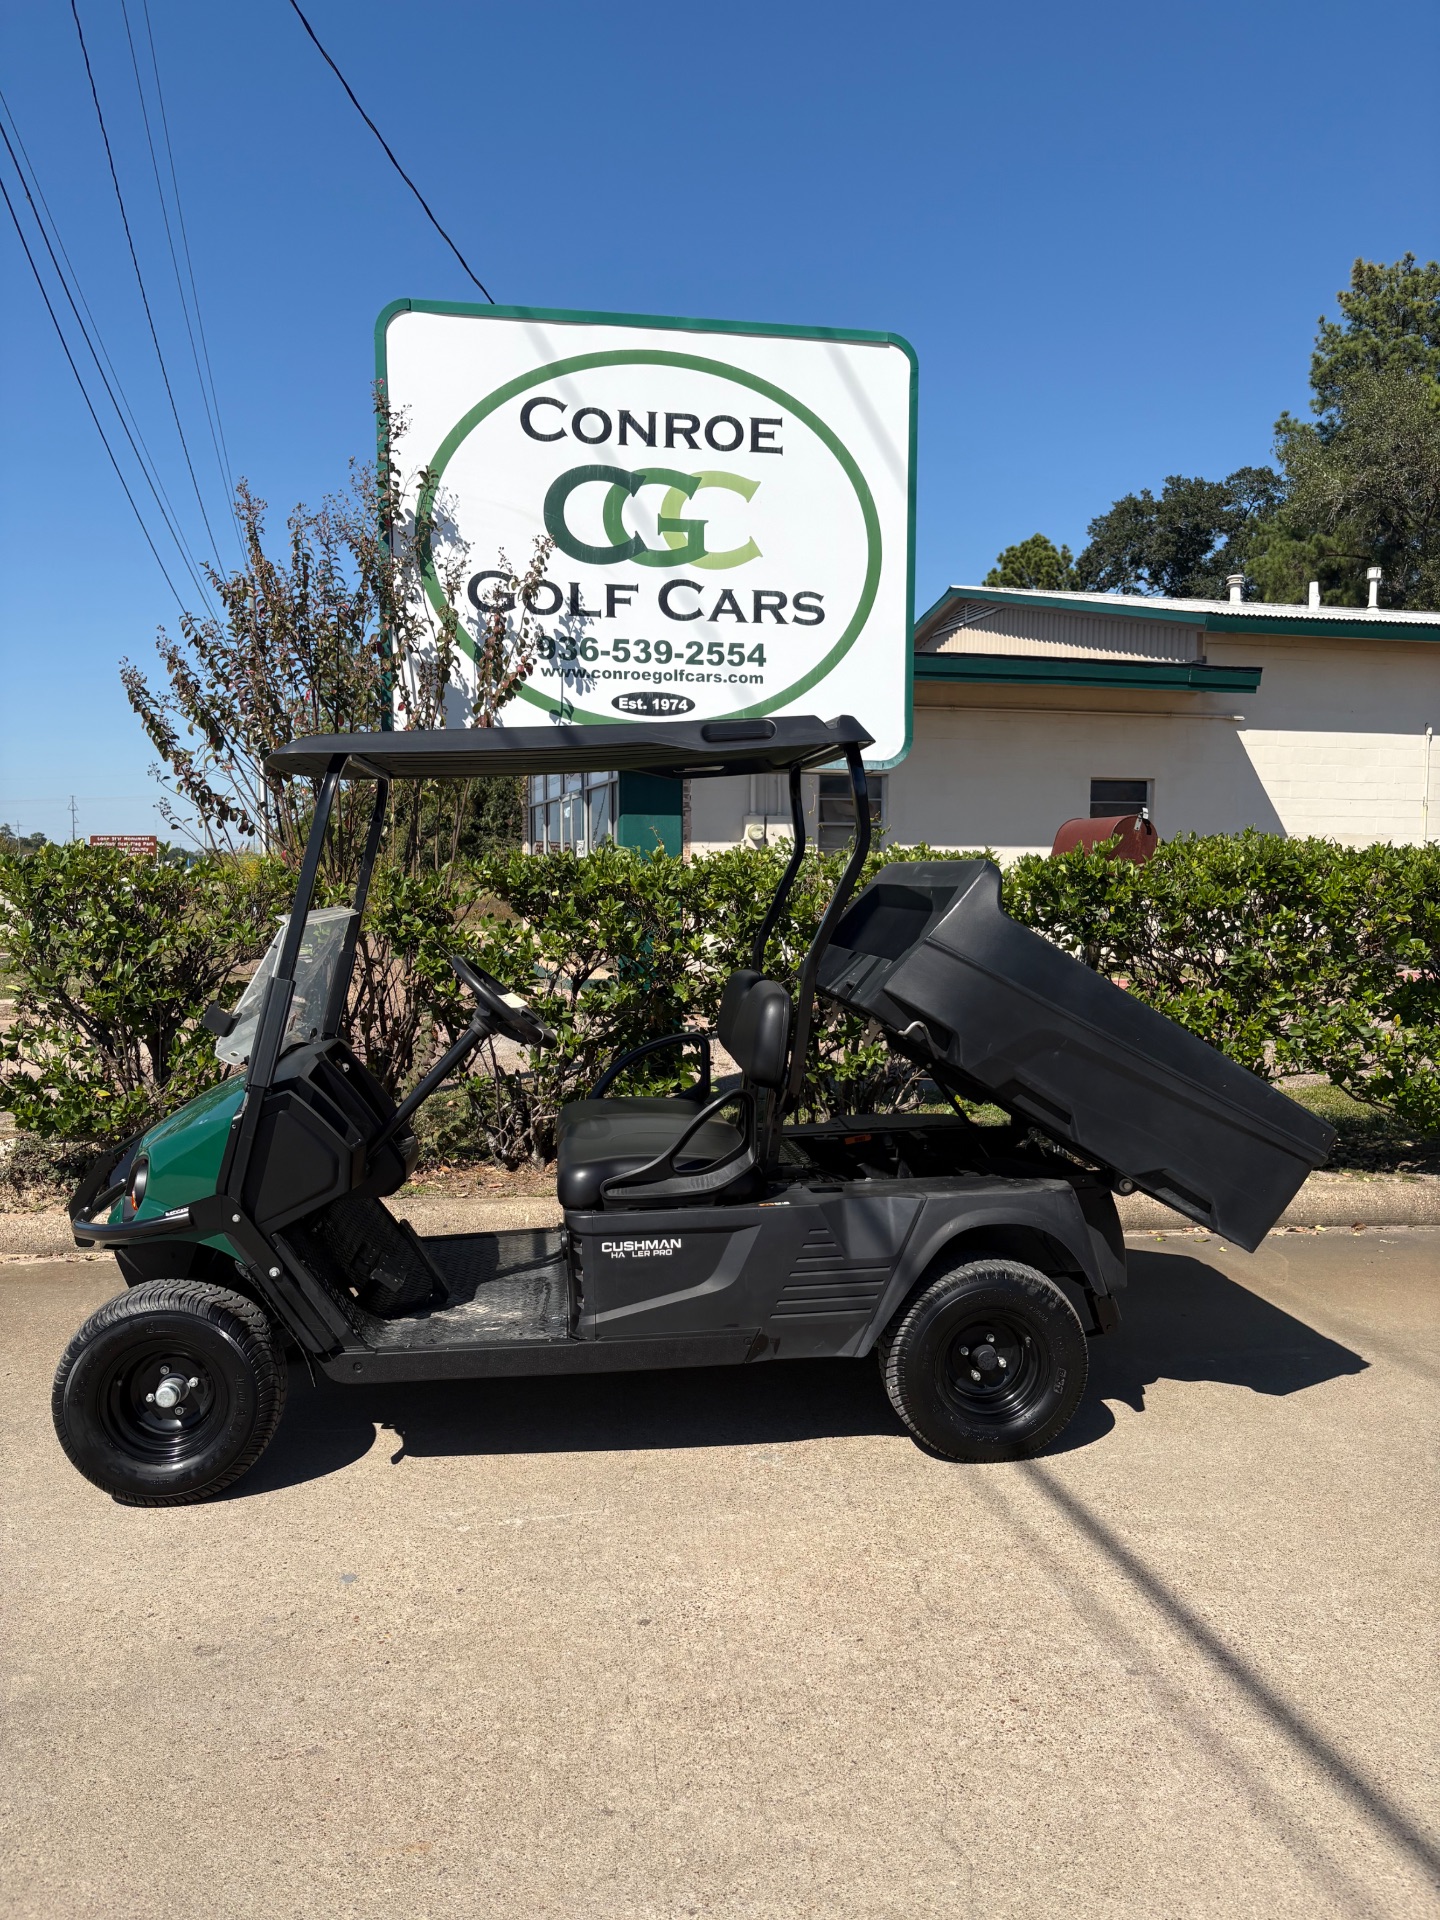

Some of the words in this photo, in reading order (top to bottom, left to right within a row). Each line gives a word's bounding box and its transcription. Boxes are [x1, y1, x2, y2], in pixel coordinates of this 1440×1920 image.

[520, 396, 784, 456] CONROE
[467, 570, 639, 620] GOLF
[658, 578, 826, 627] CARS
[537, 635, 767, 667] 936-539-2554
[541, 667, 764, 684] www.conroegolfcars.com
[618, 697, 647, 710] Est.
[652, 698, 689, 711] 1974
[601, 1238, 682, 1253] CUSHMAN
[652, 1248, 673, 1257] PRO
